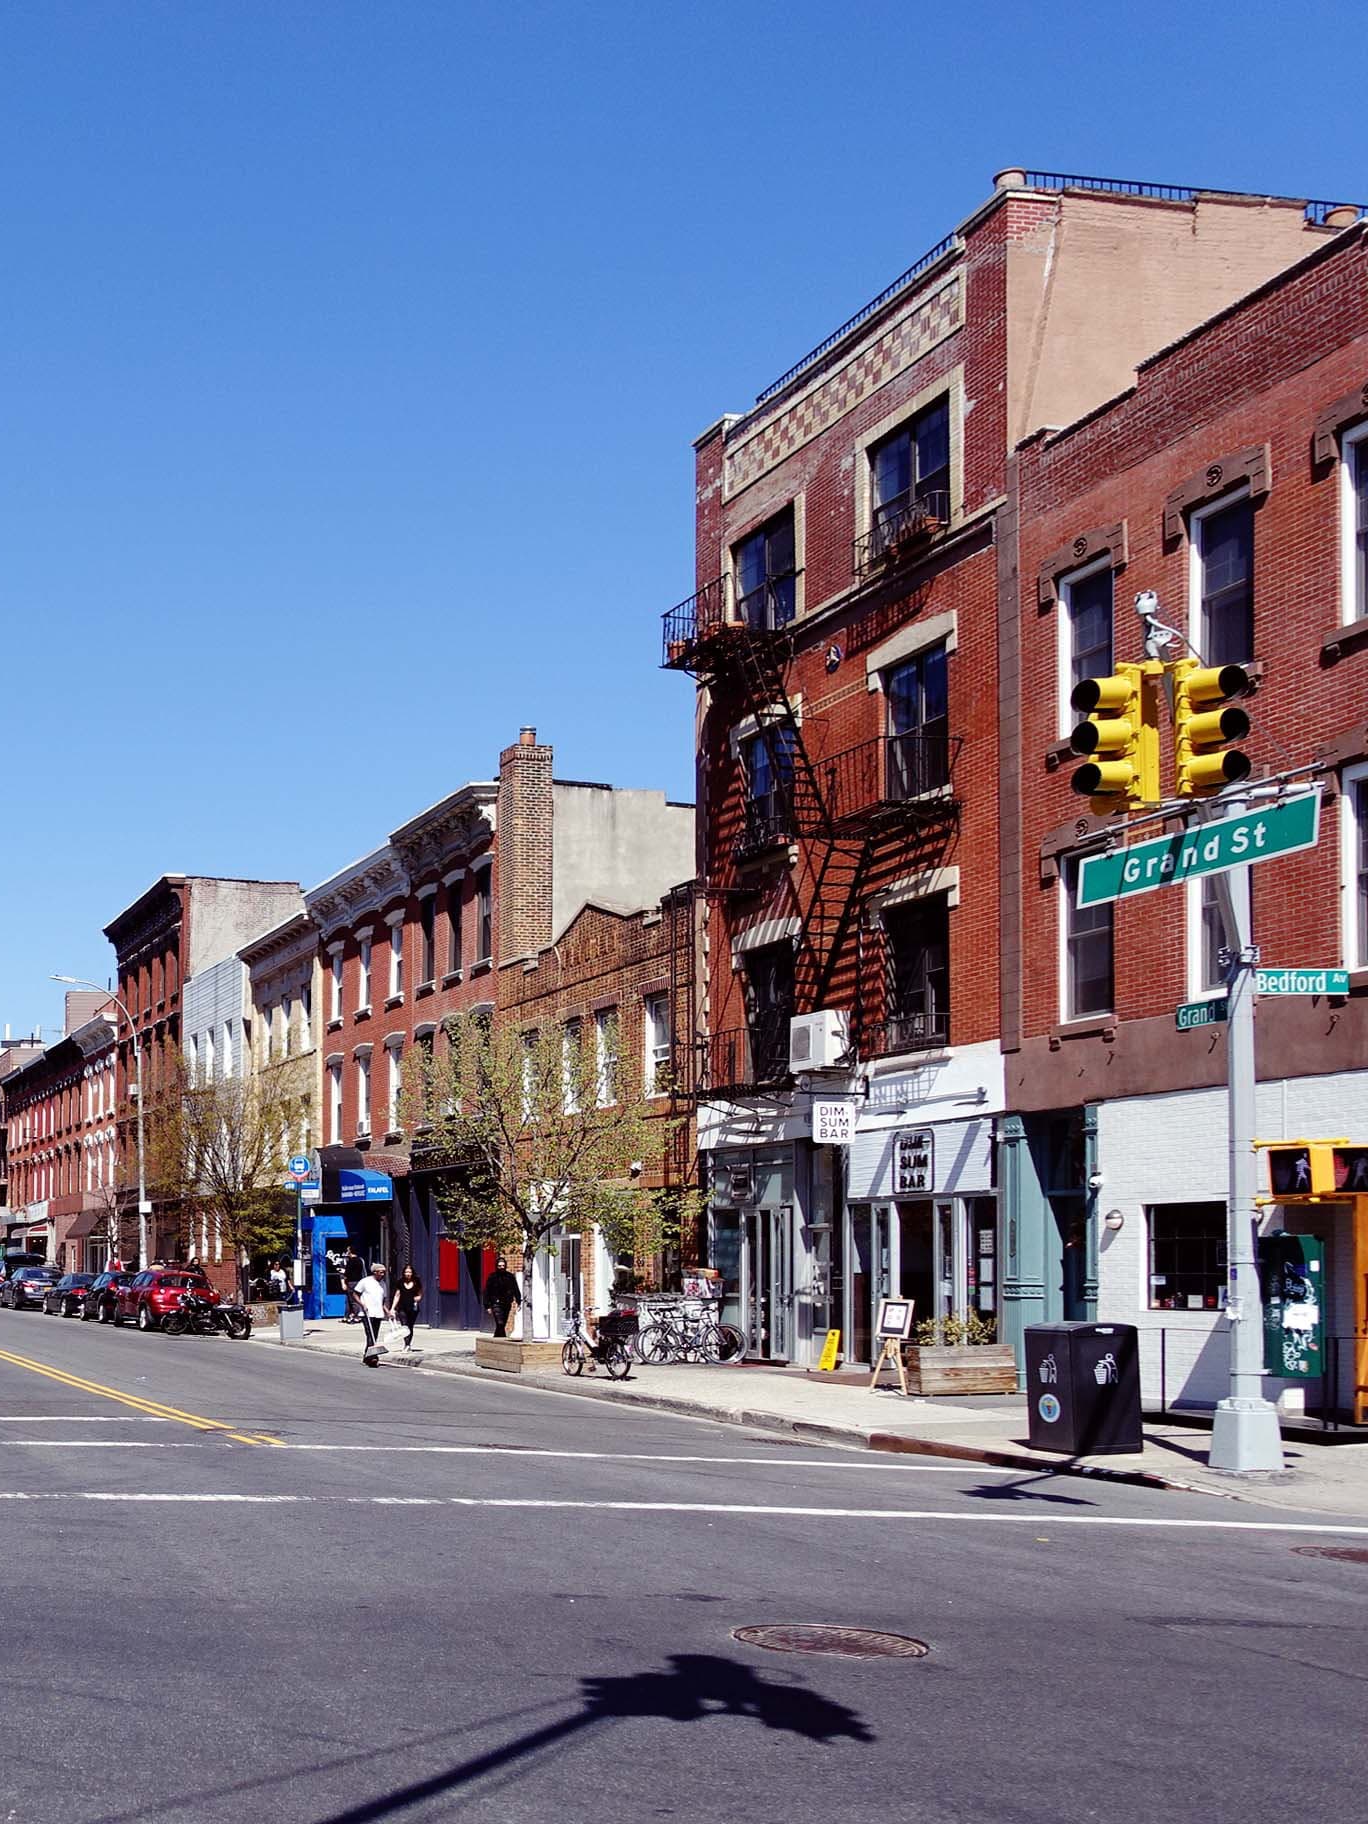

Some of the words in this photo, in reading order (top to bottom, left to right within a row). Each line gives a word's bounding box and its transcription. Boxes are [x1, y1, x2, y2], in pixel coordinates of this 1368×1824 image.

[1123, 834, 1220, 882] Grand
[1230, 821, 1267, 854] St
[1257, 972, 1326, 992] Bedford
[1178, 1002, 1215, 1027] Grand
[819, 1117, 849, 1127] SUM
[819, 1128, 849, 1138] BAR
[899, 1153, 929, 1169] SUM
[899, 1174, 926, 1189] BAR
